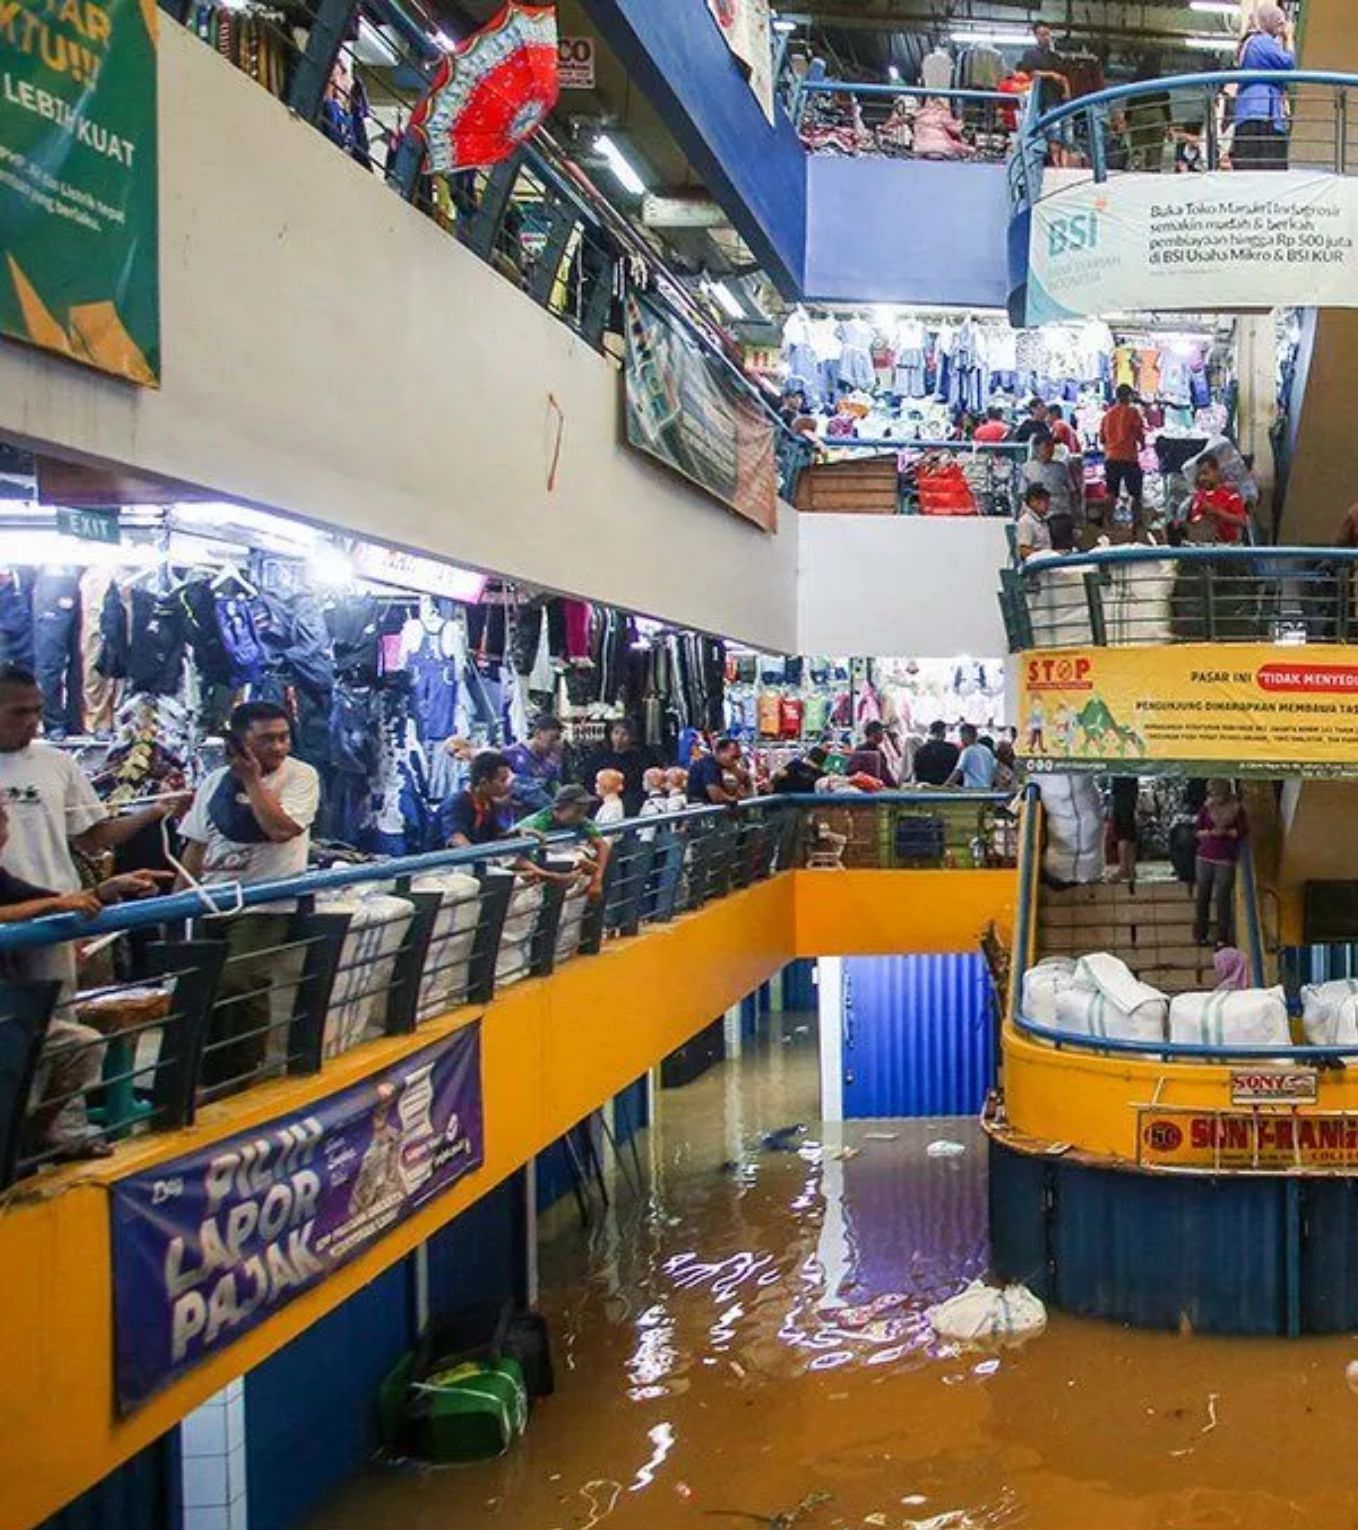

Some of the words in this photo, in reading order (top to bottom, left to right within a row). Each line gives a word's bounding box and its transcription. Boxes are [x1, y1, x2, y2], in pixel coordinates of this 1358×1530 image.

[4, 72, 76, 133] LEBIH
[78, 122, 135, 168] KUAT
[1151, 205, 1183, 218] Buka
[1187, 203, 1216, 216] Toko
[1050, 212, 1098, 255] BSI
[1151, 219, 1202, 232] semakin
[1205, 218, 1250, 231] mudah
[1253, 219, 1263, 230] &
[1266, 218, 1314, 231] berkah
[1150, 235, 1227, 249] pembiayaan
[1230, 234, 1274, 248] hingga
[1276, 234, 1295, 247] Rp
[1299, 235, 1324, 247] 500
[1326, 235, 1352, 248] juta
[1150, 250, 1160, 264] di
[1163, 250, 1184, 264] BSI
[1187, 249, 1228, 263] Usaha
[1230, 249, 1272, 261] Mikro
[1273, 250, 1284, 261] &
[1287, 250, 1309, 262] BSI
[1312, 250, 1344, 263] KUR
[70, 515, 109, 538] EXIT
[1028, 659, 1091, 681] STOP
[1191, 671, 1229, 683] PASAR
[1233, 671, 1252, 683] INI
[1136, 701, 1202, 711] PENGUNJUNG
[1278, 702, 1336, 713] MEMBAWA
[206, 1116, 324, 1214] PILIH
[164, 1170, 321, 1299] LAPOR
[171, 1219, 325, 1366] PAJAK
